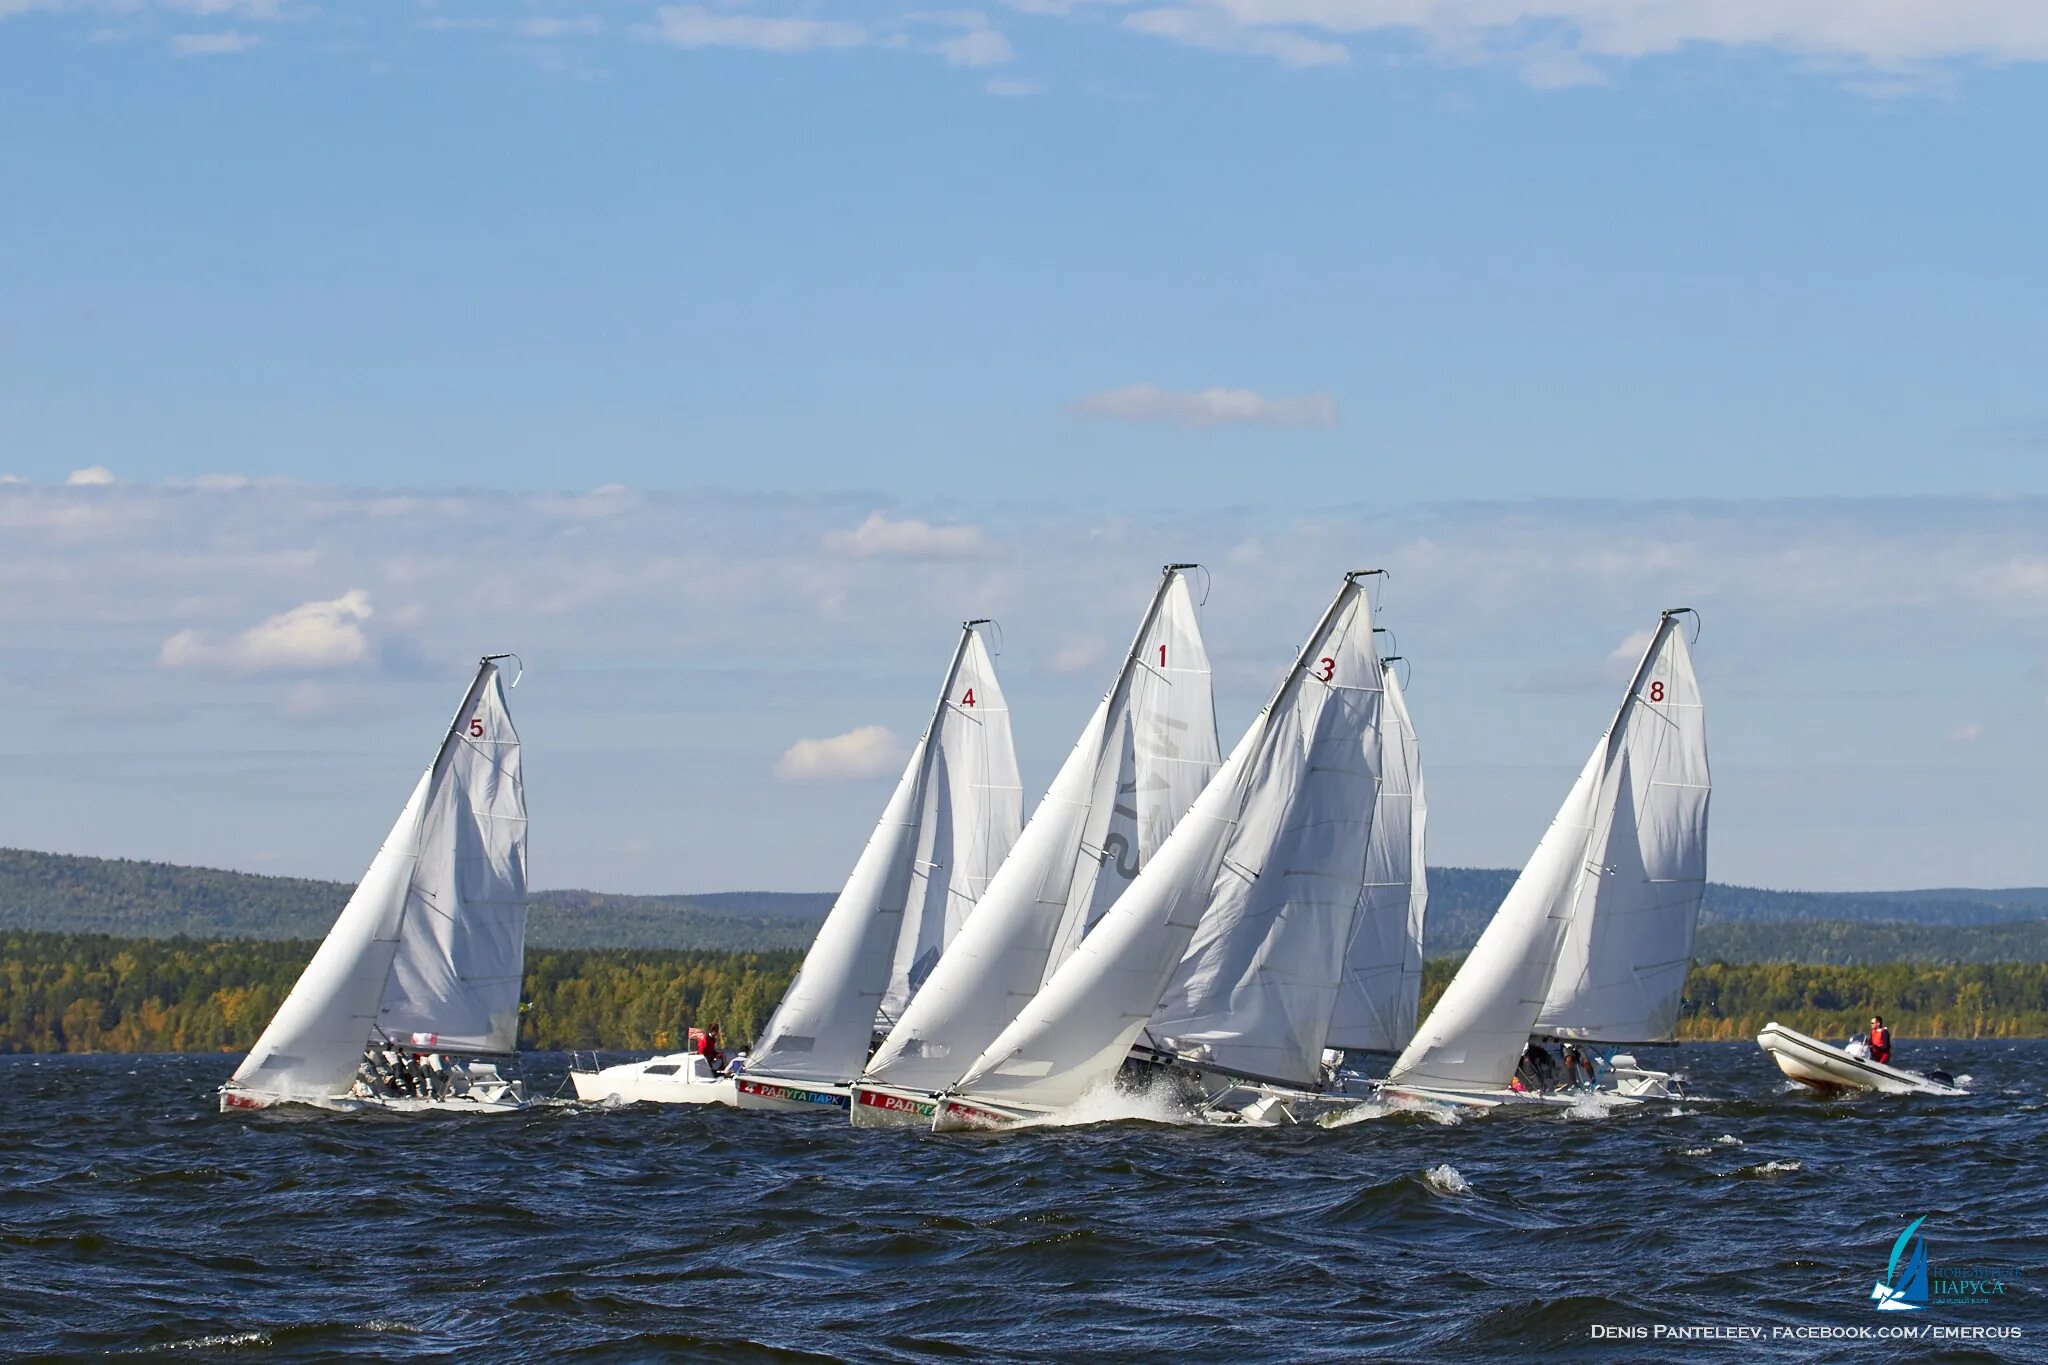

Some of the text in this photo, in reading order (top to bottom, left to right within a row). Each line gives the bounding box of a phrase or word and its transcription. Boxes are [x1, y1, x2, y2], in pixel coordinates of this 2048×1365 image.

[1159, 644, 1166, 667] 1
[1316, 657, 1335, 682] 3
[962, 688, 976, 707] 4
[1650, 681, 1664, 702] 8
[470, 719, 484, 738] 5
[744, 1081, 756, 1094] 4
[869, 1094, 877, 1105] 1
